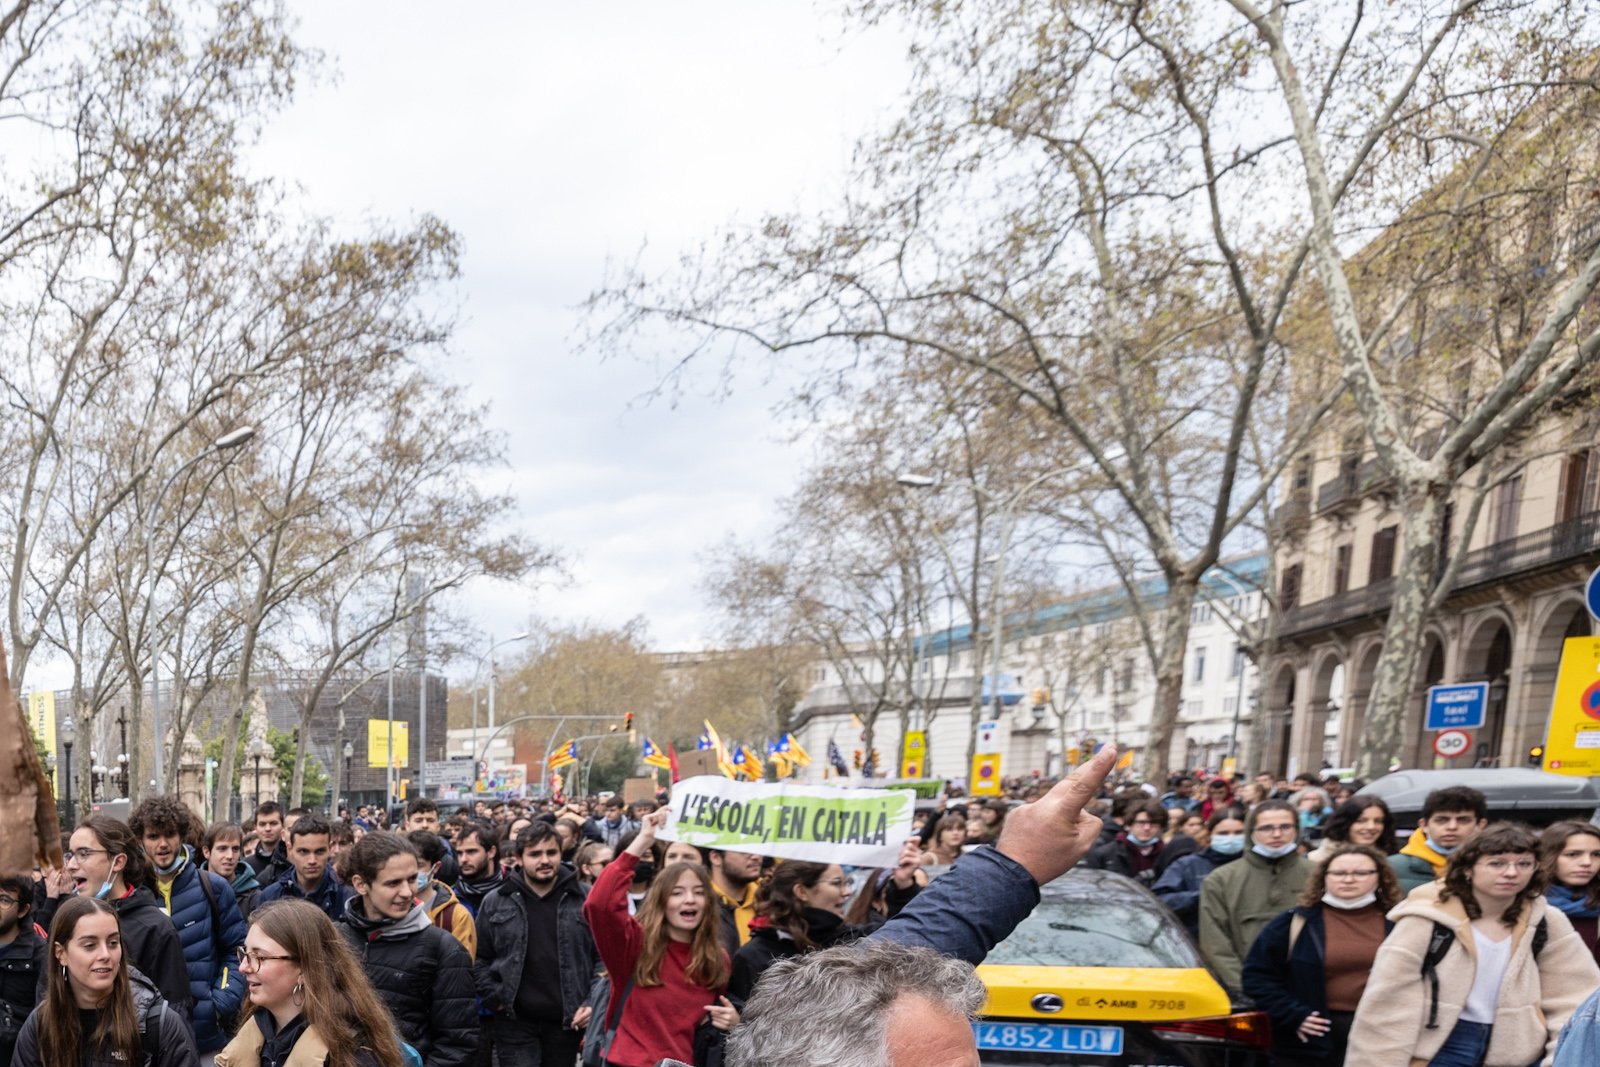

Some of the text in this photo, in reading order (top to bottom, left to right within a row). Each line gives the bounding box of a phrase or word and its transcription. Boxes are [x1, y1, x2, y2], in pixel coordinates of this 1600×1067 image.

[678, 793, 888, 846] L'ESCOLA, EN CATALÀ
[1148, 999, 1186, 1011] 7908
[984, 1025, 1054, 1049] 4852
